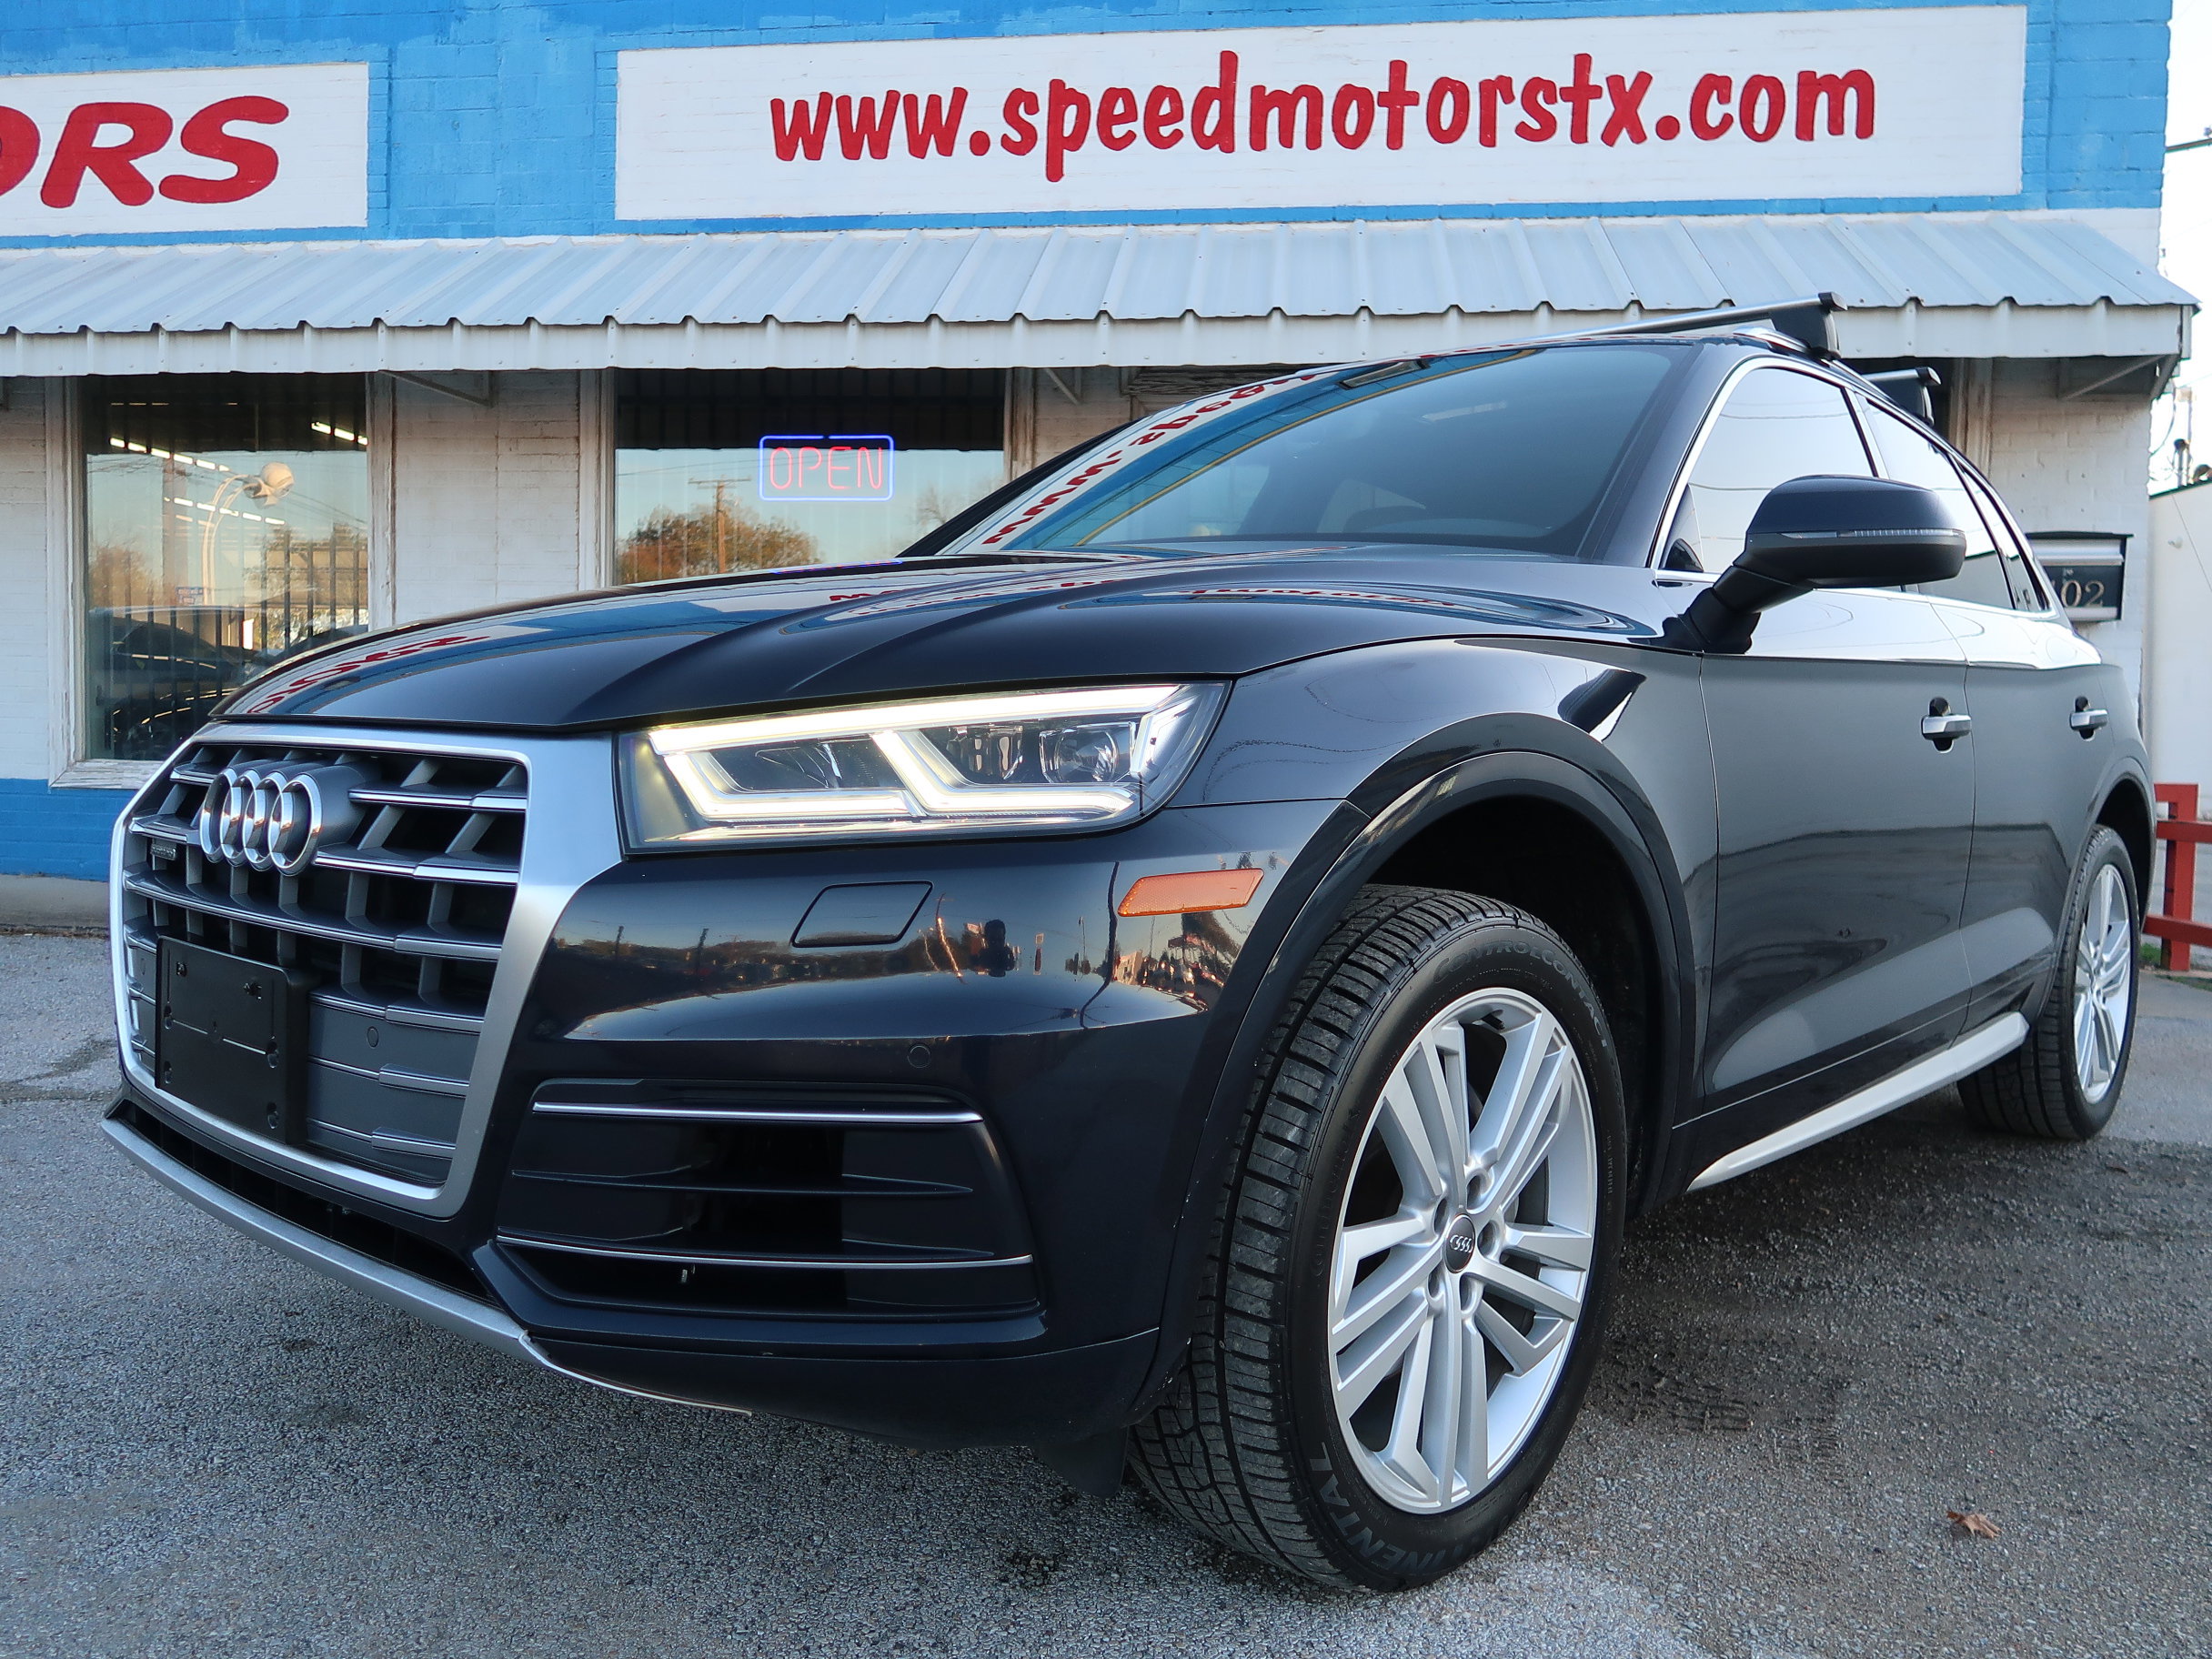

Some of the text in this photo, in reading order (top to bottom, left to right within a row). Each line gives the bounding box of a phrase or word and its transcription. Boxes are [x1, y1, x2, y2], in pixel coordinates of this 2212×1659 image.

[771, 51, 1875, 183] www.speedmotorstx.com
[769, 446, 883, 490] OPEN
[2052, 579, 2105, 607] 02
